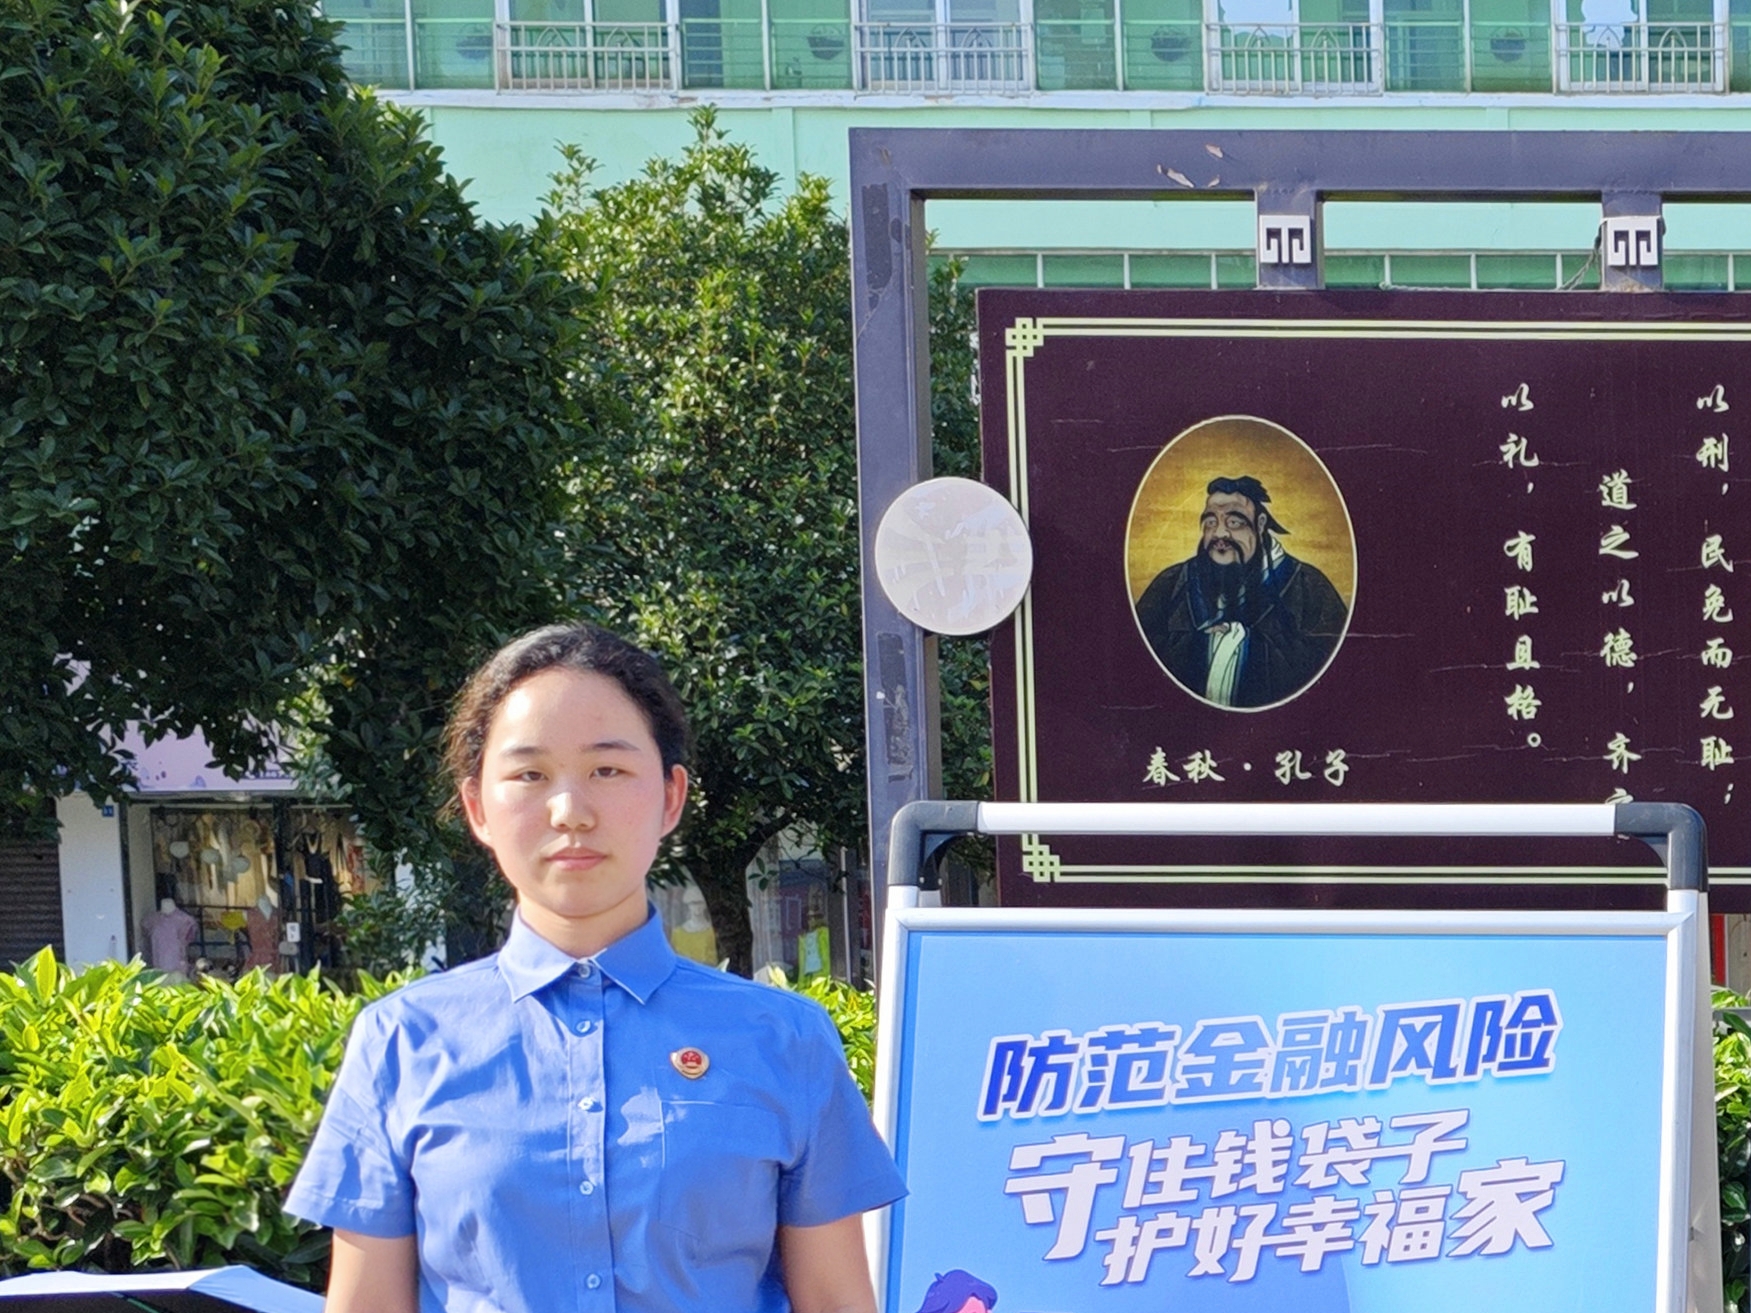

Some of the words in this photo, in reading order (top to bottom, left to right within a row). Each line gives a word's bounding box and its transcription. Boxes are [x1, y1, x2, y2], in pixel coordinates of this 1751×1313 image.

[979, 989, 1562, 1121] 防范金融风险
[1004, 1109, 1471, 1261] 守住钱袋子
[1095, 1158, 1566, 1285] 护好幸福家
